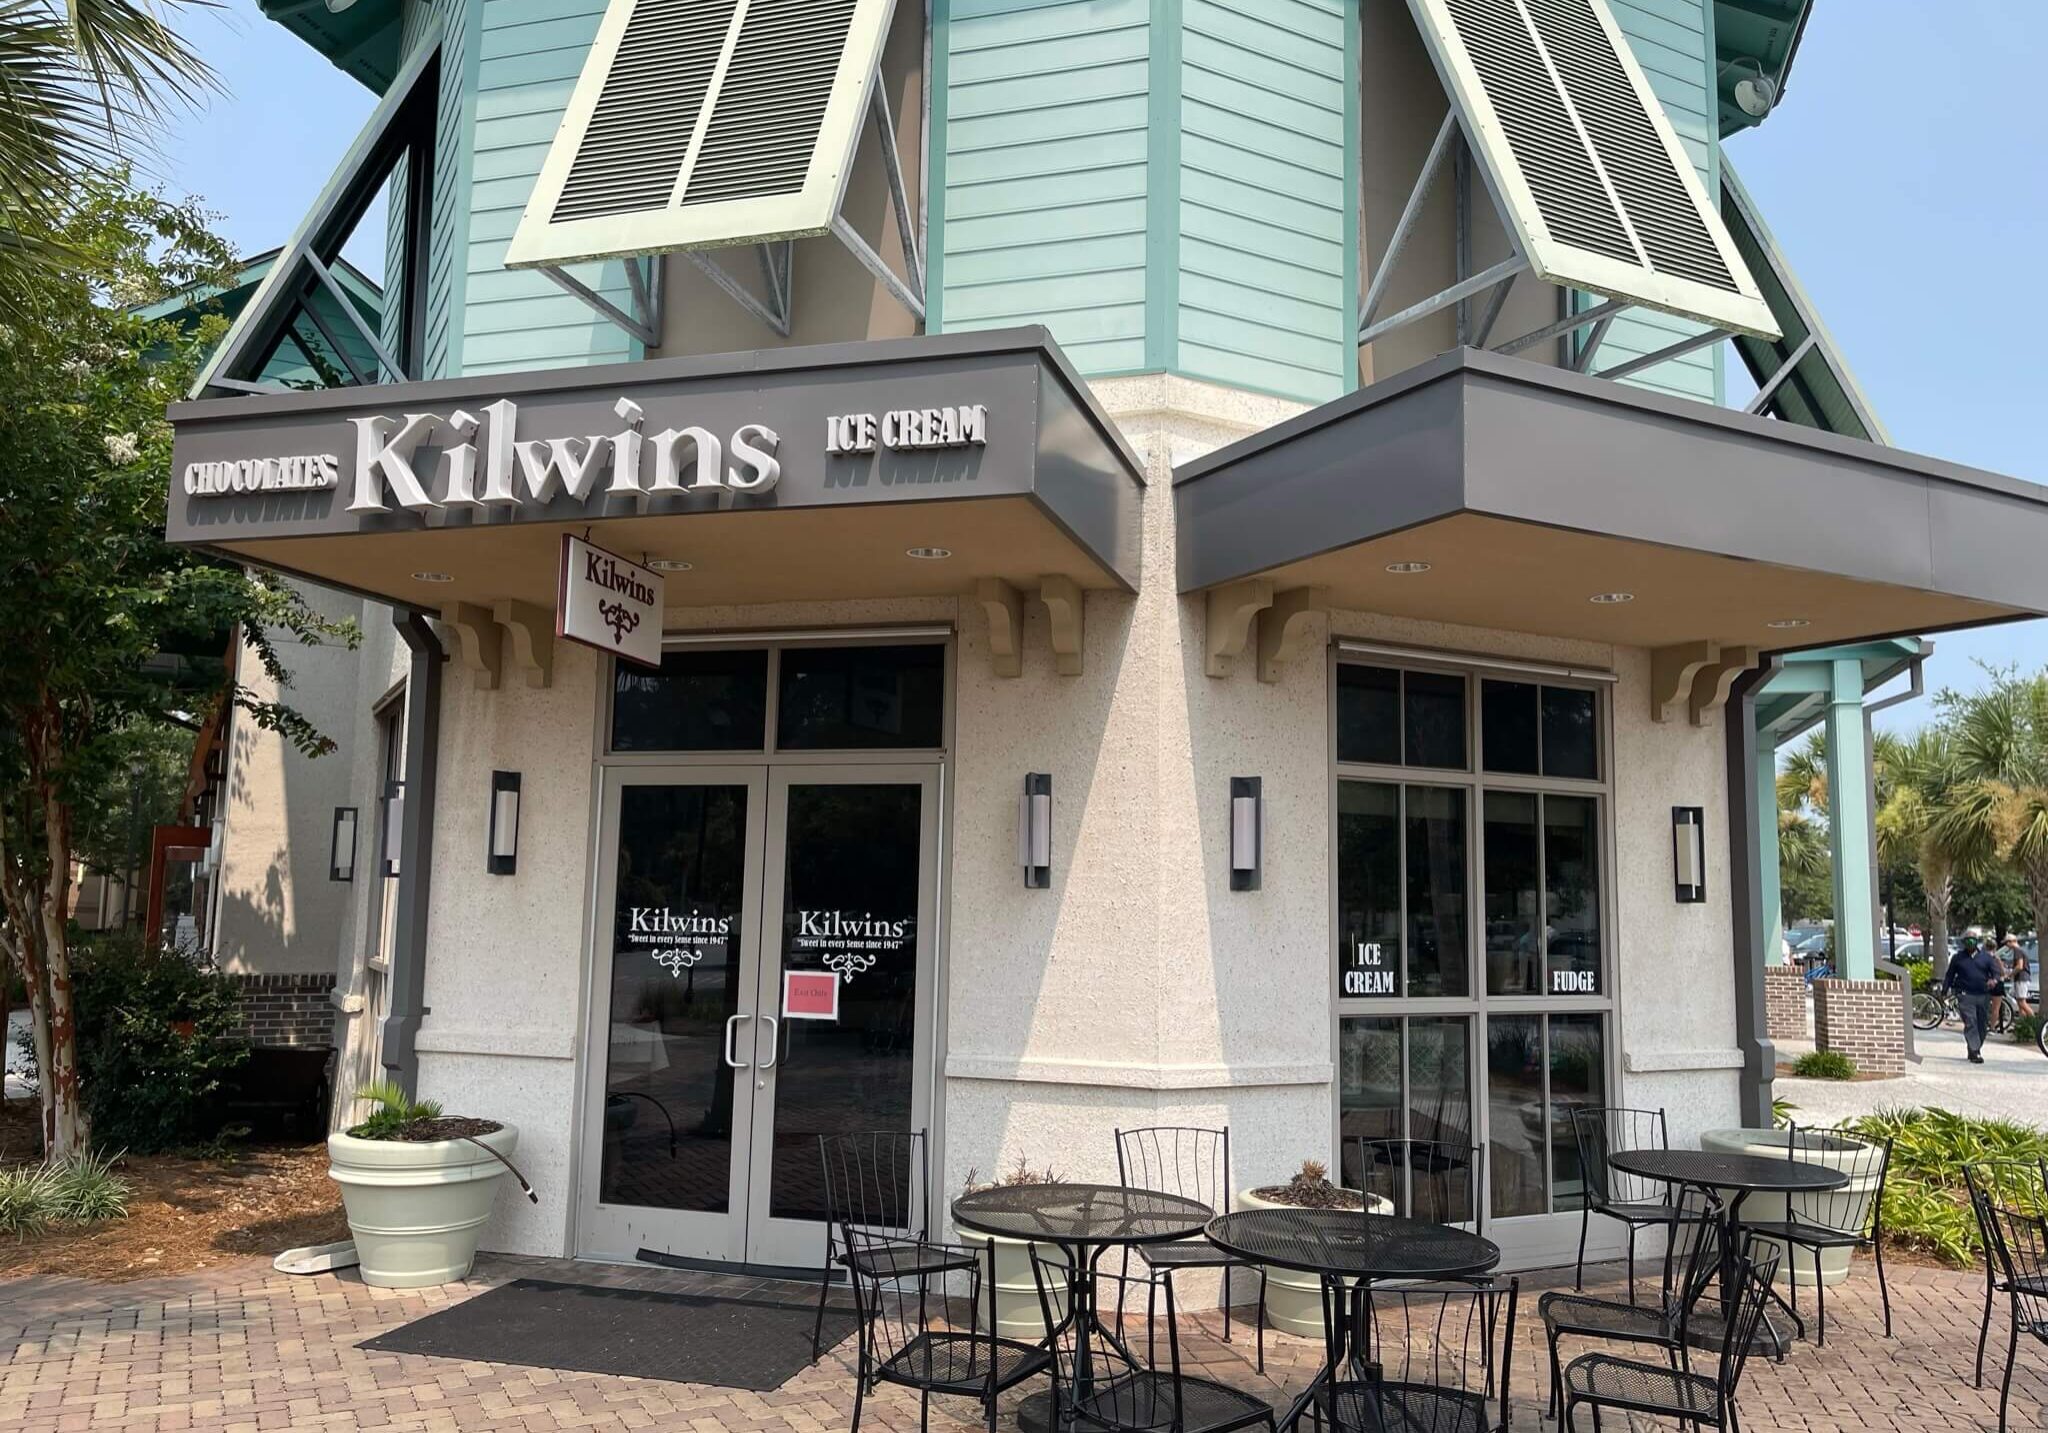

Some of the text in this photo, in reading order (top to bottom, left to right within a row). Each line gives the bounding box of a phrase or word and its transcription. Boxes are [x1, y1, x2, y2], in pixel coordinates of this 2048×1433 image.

[826, 404, 987, 454] ICE CREAM
[345, 397, 780, 513] Kilwins
[184, 454, 338, 497] CHOCOLATES
[585, 550, 655, 607] Kilwins
[630, 907, 729, 934] Kilwins
[799, 910, 904, 938] Kilwins
[657, 935, 673, 945] every
[692, 936, 708, 944] since
[828, 940, 845, 949] every
[865, 941, 882, 949] since
[1358, 943, 1381, 965] ICE
[1344, 971, 1394, 993] CREAM
[1553, 971, 1595, 992] FUDGE
